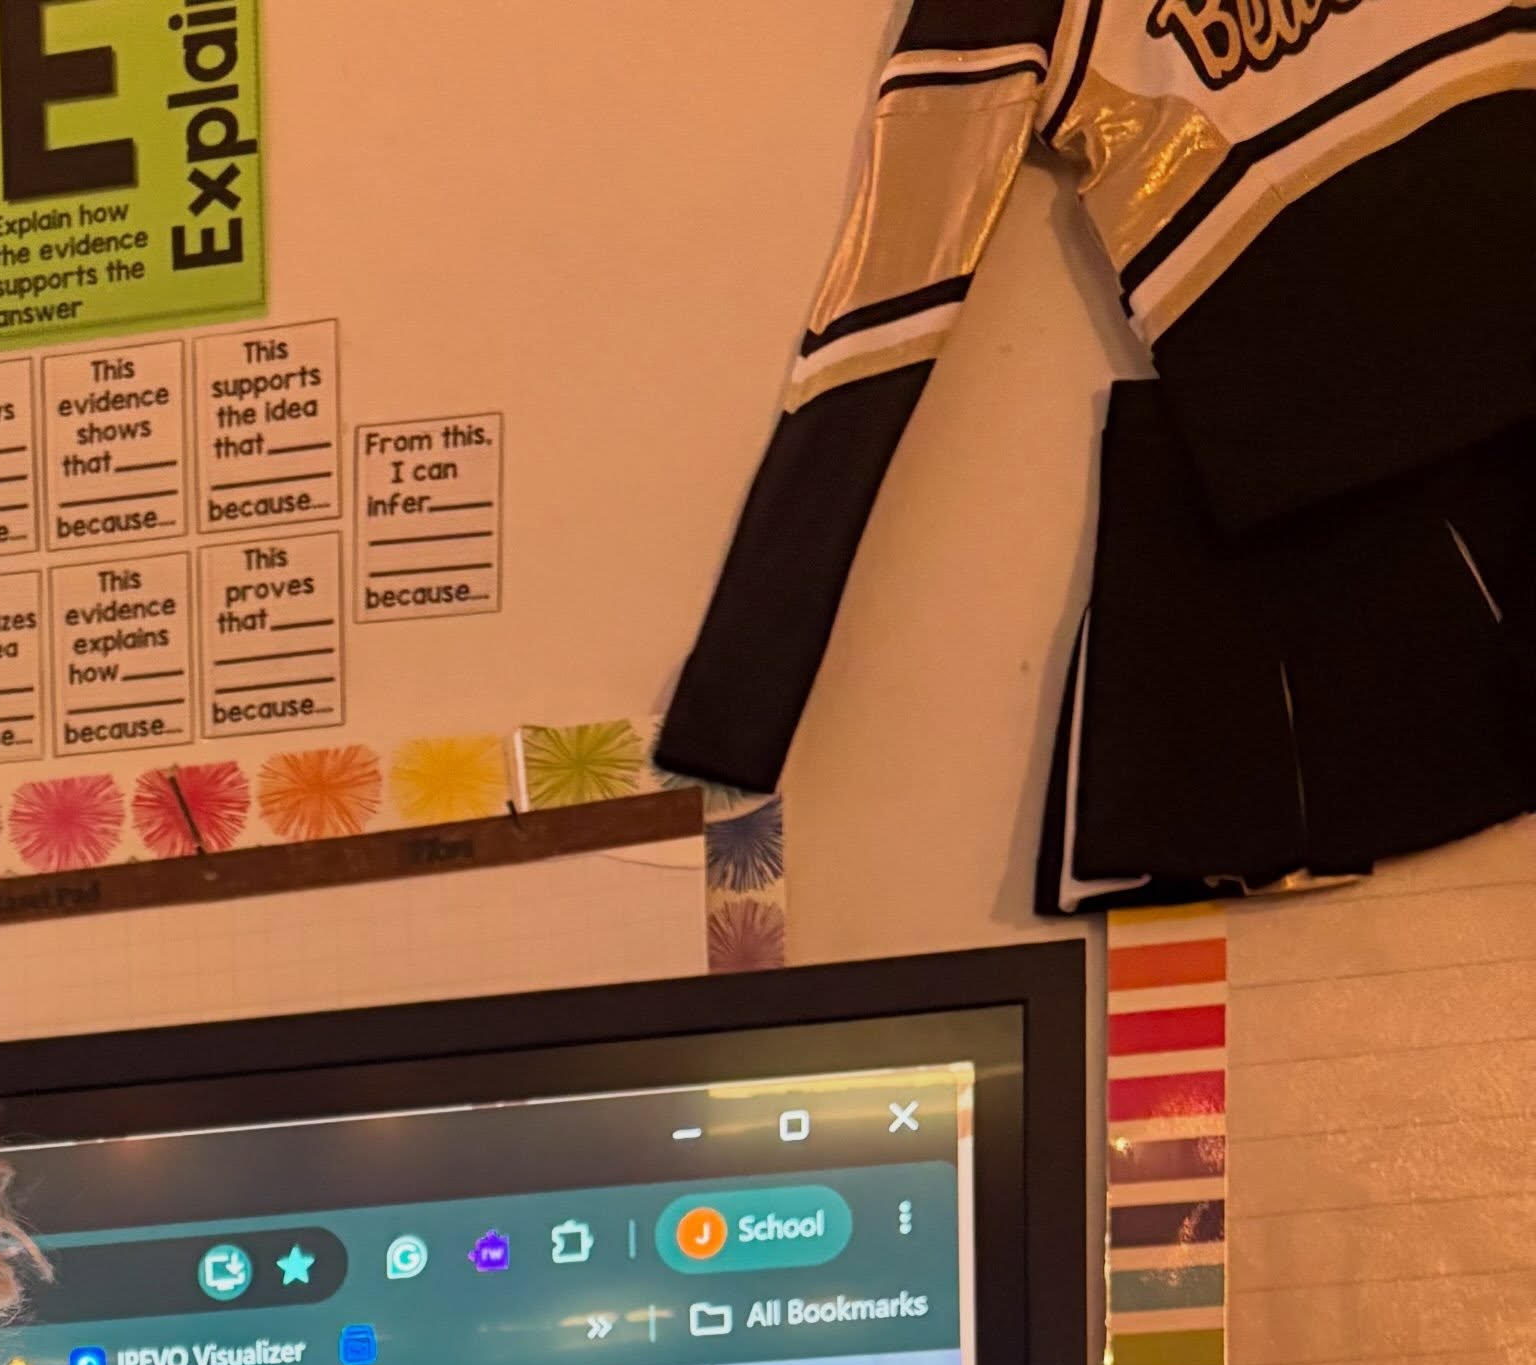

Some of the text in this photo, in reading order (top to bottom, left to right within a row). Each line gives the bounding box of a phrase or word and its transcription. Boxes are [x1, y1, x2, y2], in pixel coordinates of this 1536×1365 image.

[0, 0, 138, 204] E
[167, 0, 258, 271] Explai
[78, 204, 129, 227] how
[39, 231, 148, 261] evidence
[105, 259, 145, 282] the
[211, 365, 321, 401] supports
[57, 387, 169, 417] evidence
[216, 398, 318, 428] the idea
[76, 420, 152, 445] shows
[365, 432, 432, 455] From
[412, 462, 458, 481] can
[367, 492, 431, 517] infer
[225, 577, 314, 607] proves
[64, 598, 176, 626] evidence
[72, 627, 169, 657] explains
[68, 663, 119, 685] how
[738, 1210, 824, 1242] School
[746, 1290, 929, 1327] All Bookmarks
